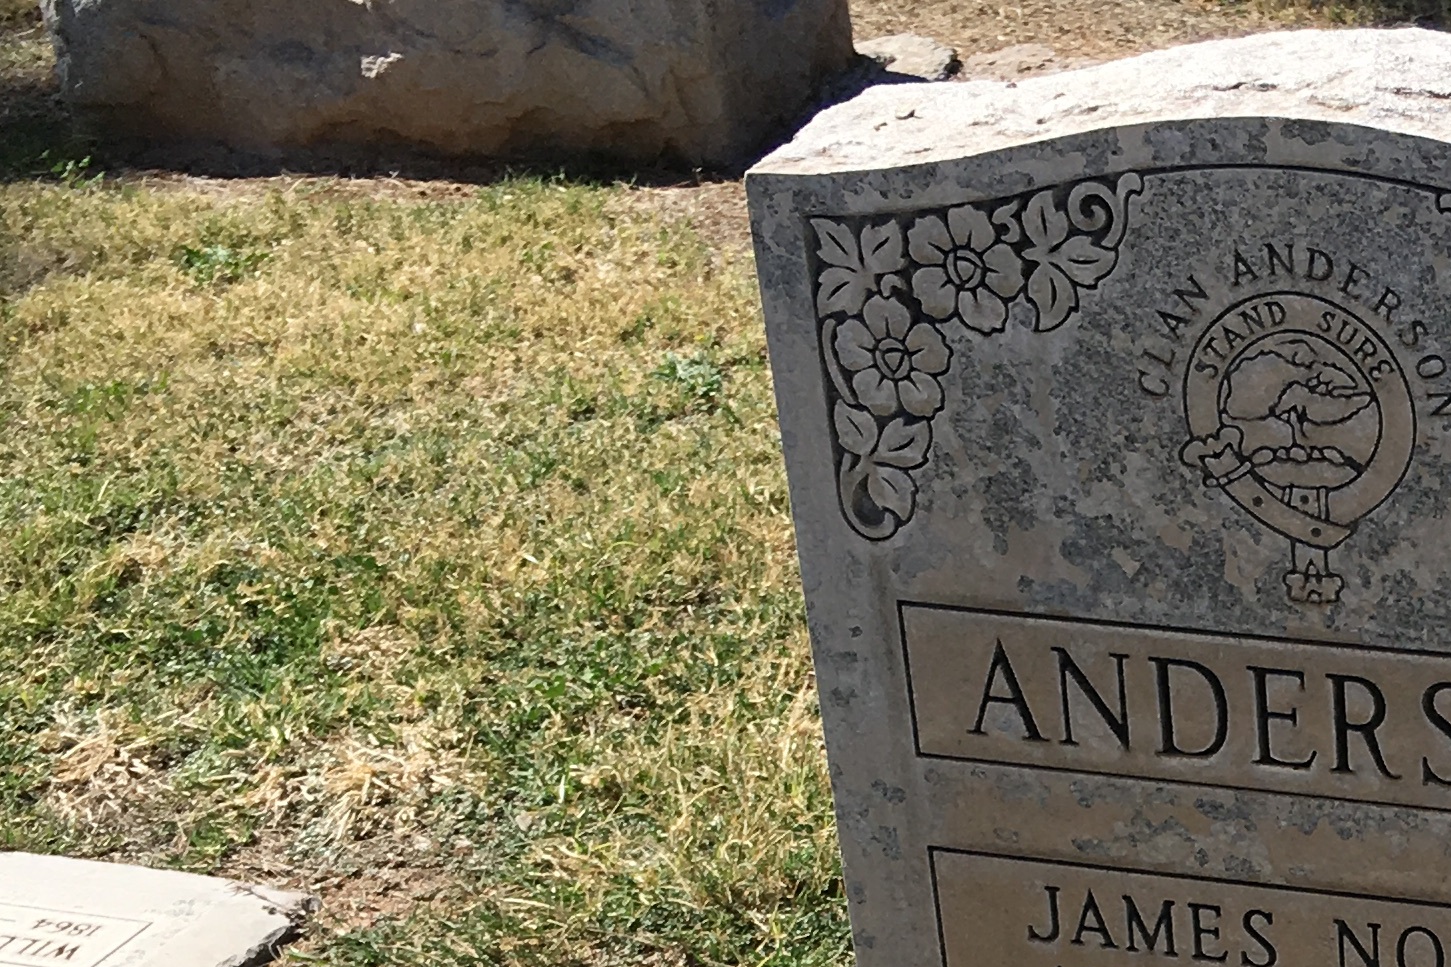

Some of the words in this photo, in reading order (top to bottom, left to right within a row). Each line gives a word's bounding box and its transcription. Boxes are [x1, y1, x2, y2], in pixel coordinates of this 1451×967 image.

[1137, 273, 1209, 398] CLAN
[1195, 301, 1287, 379] STAND
[1317, 311, 1396, 382] SURE
